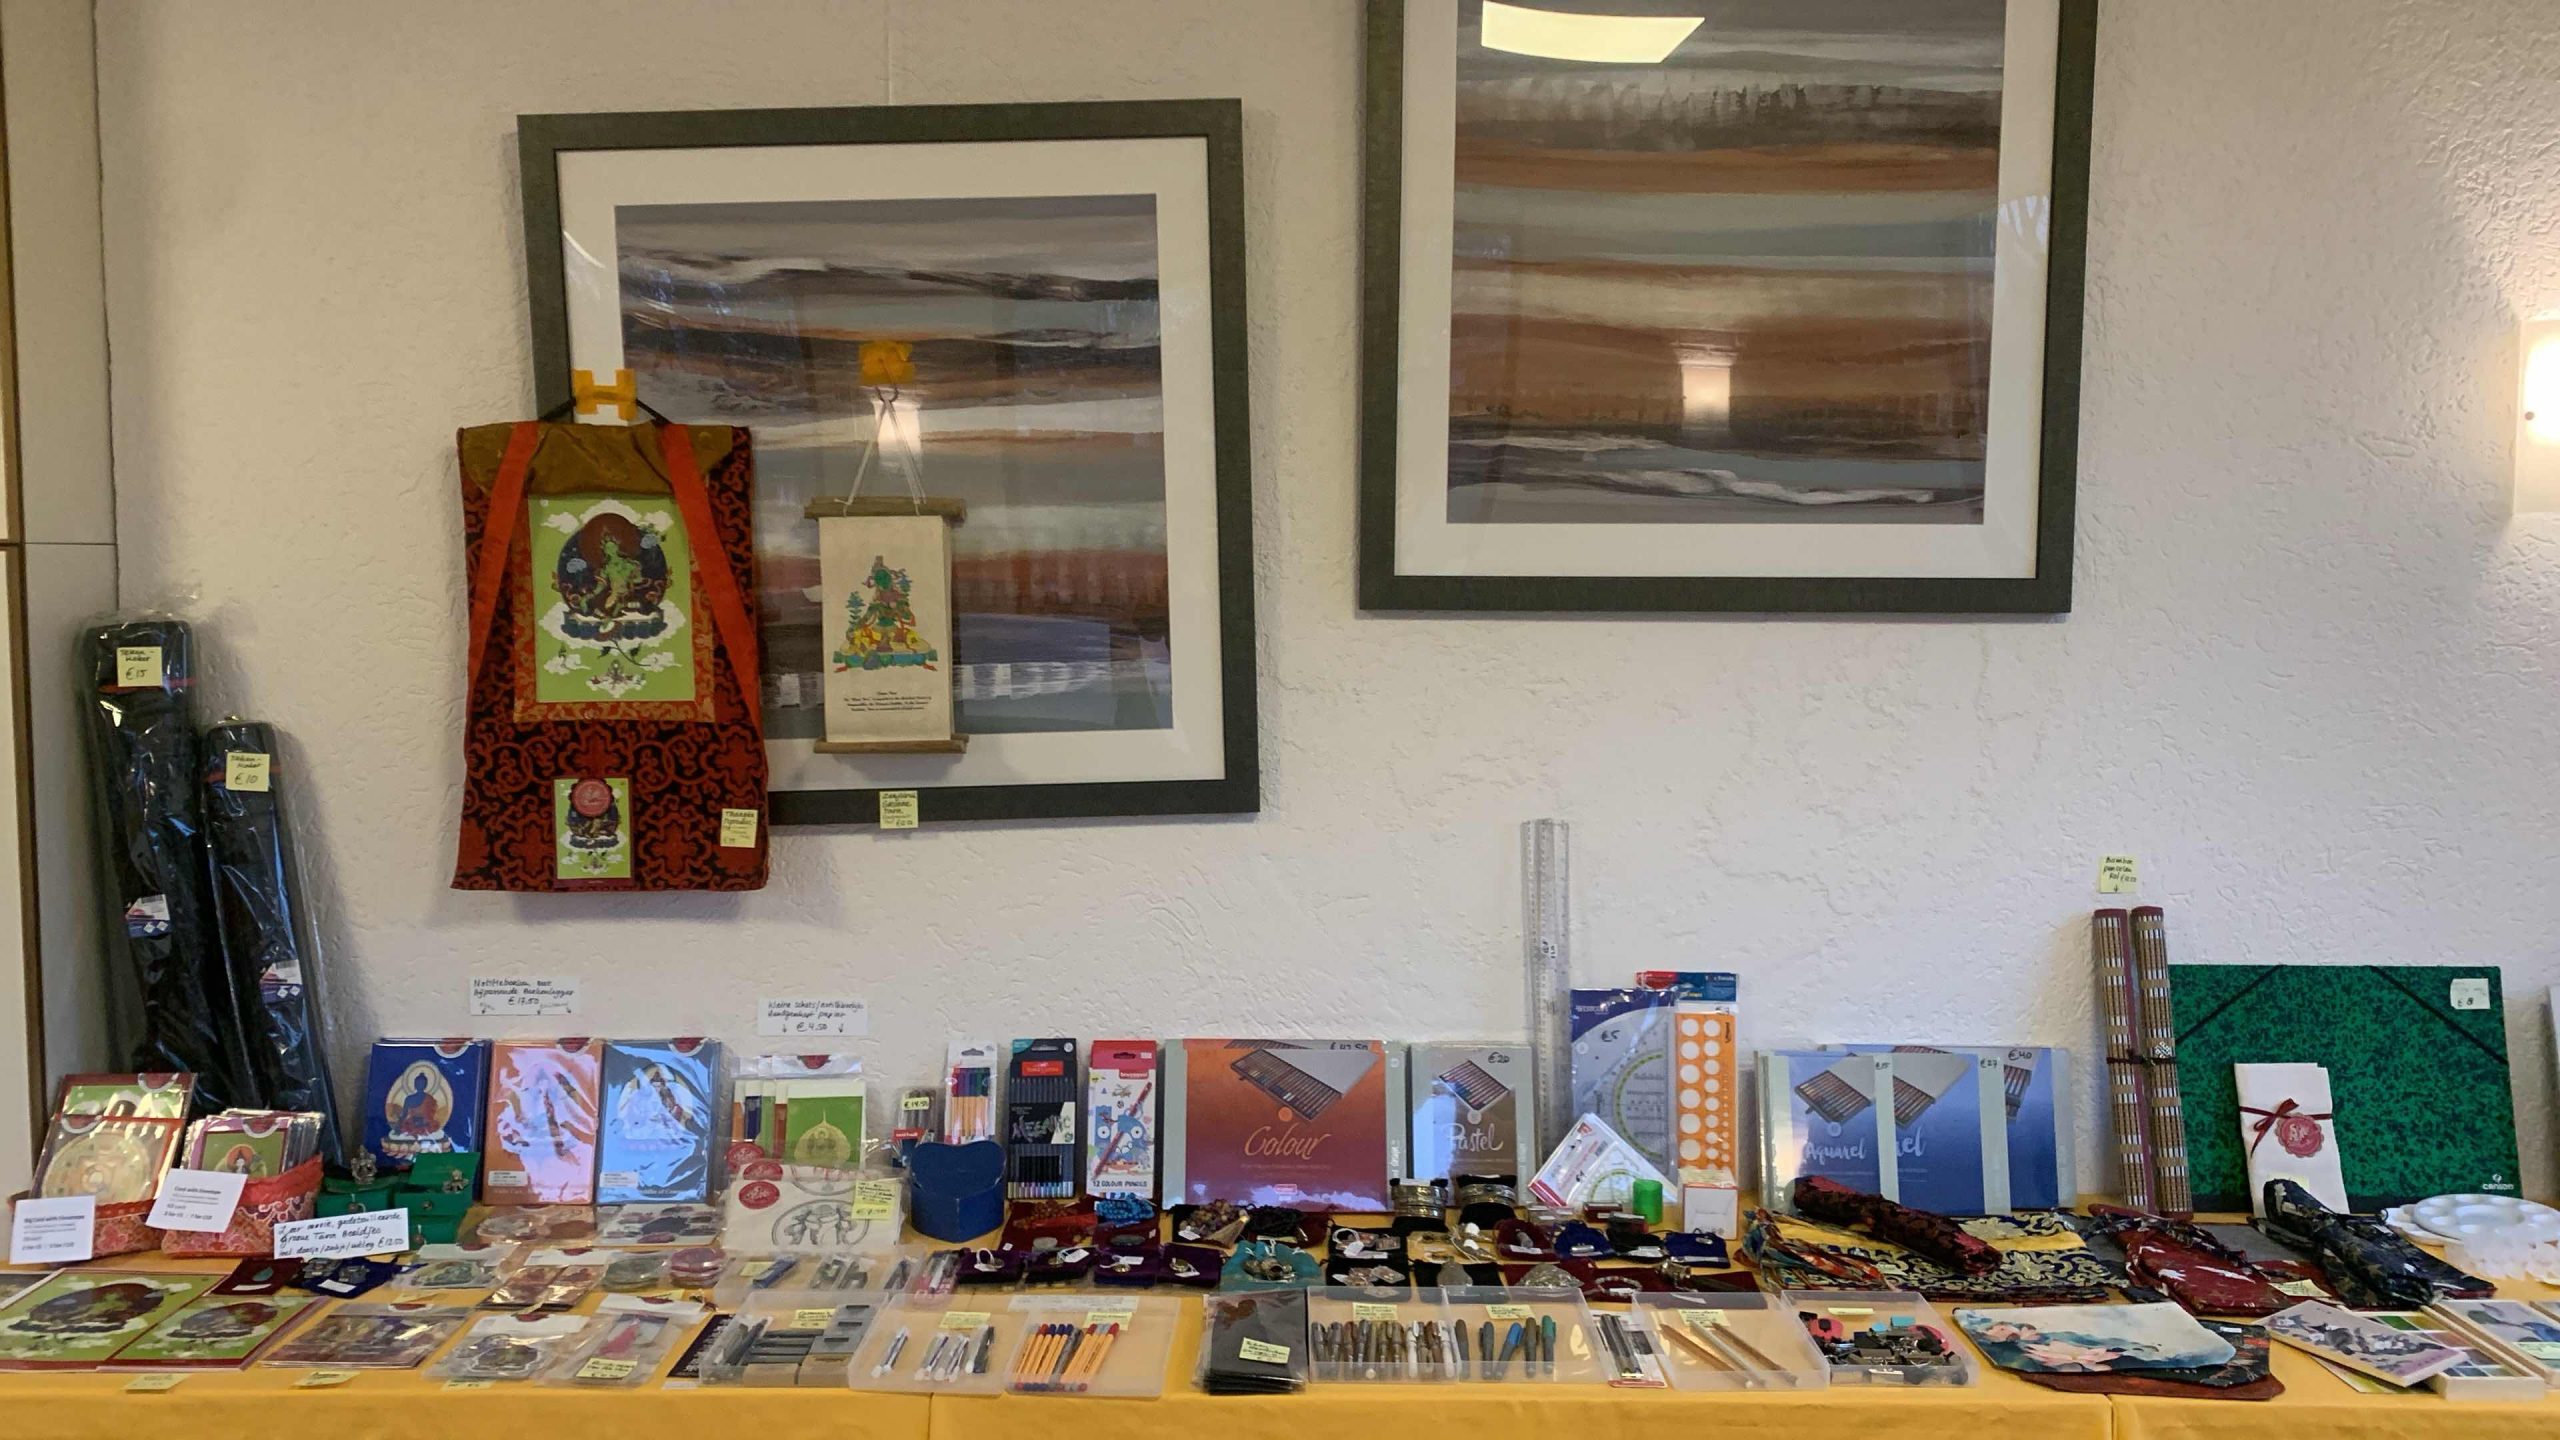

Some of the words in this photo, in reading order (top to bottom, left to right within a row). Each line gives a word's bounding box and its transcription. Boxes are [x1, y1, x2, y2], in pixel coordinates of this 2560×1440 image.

[1601, 1030, 1620, 1042] €5
[1487, 1051, 1511, 1064] €20
[2008, 1049, 2033, 1061] €40
[1244, 1122, 1332, 1160] Colour
[1443, 1123, 1504, 1152] Pastel
[1804, 1137, 1867, 1166] Aquarel
